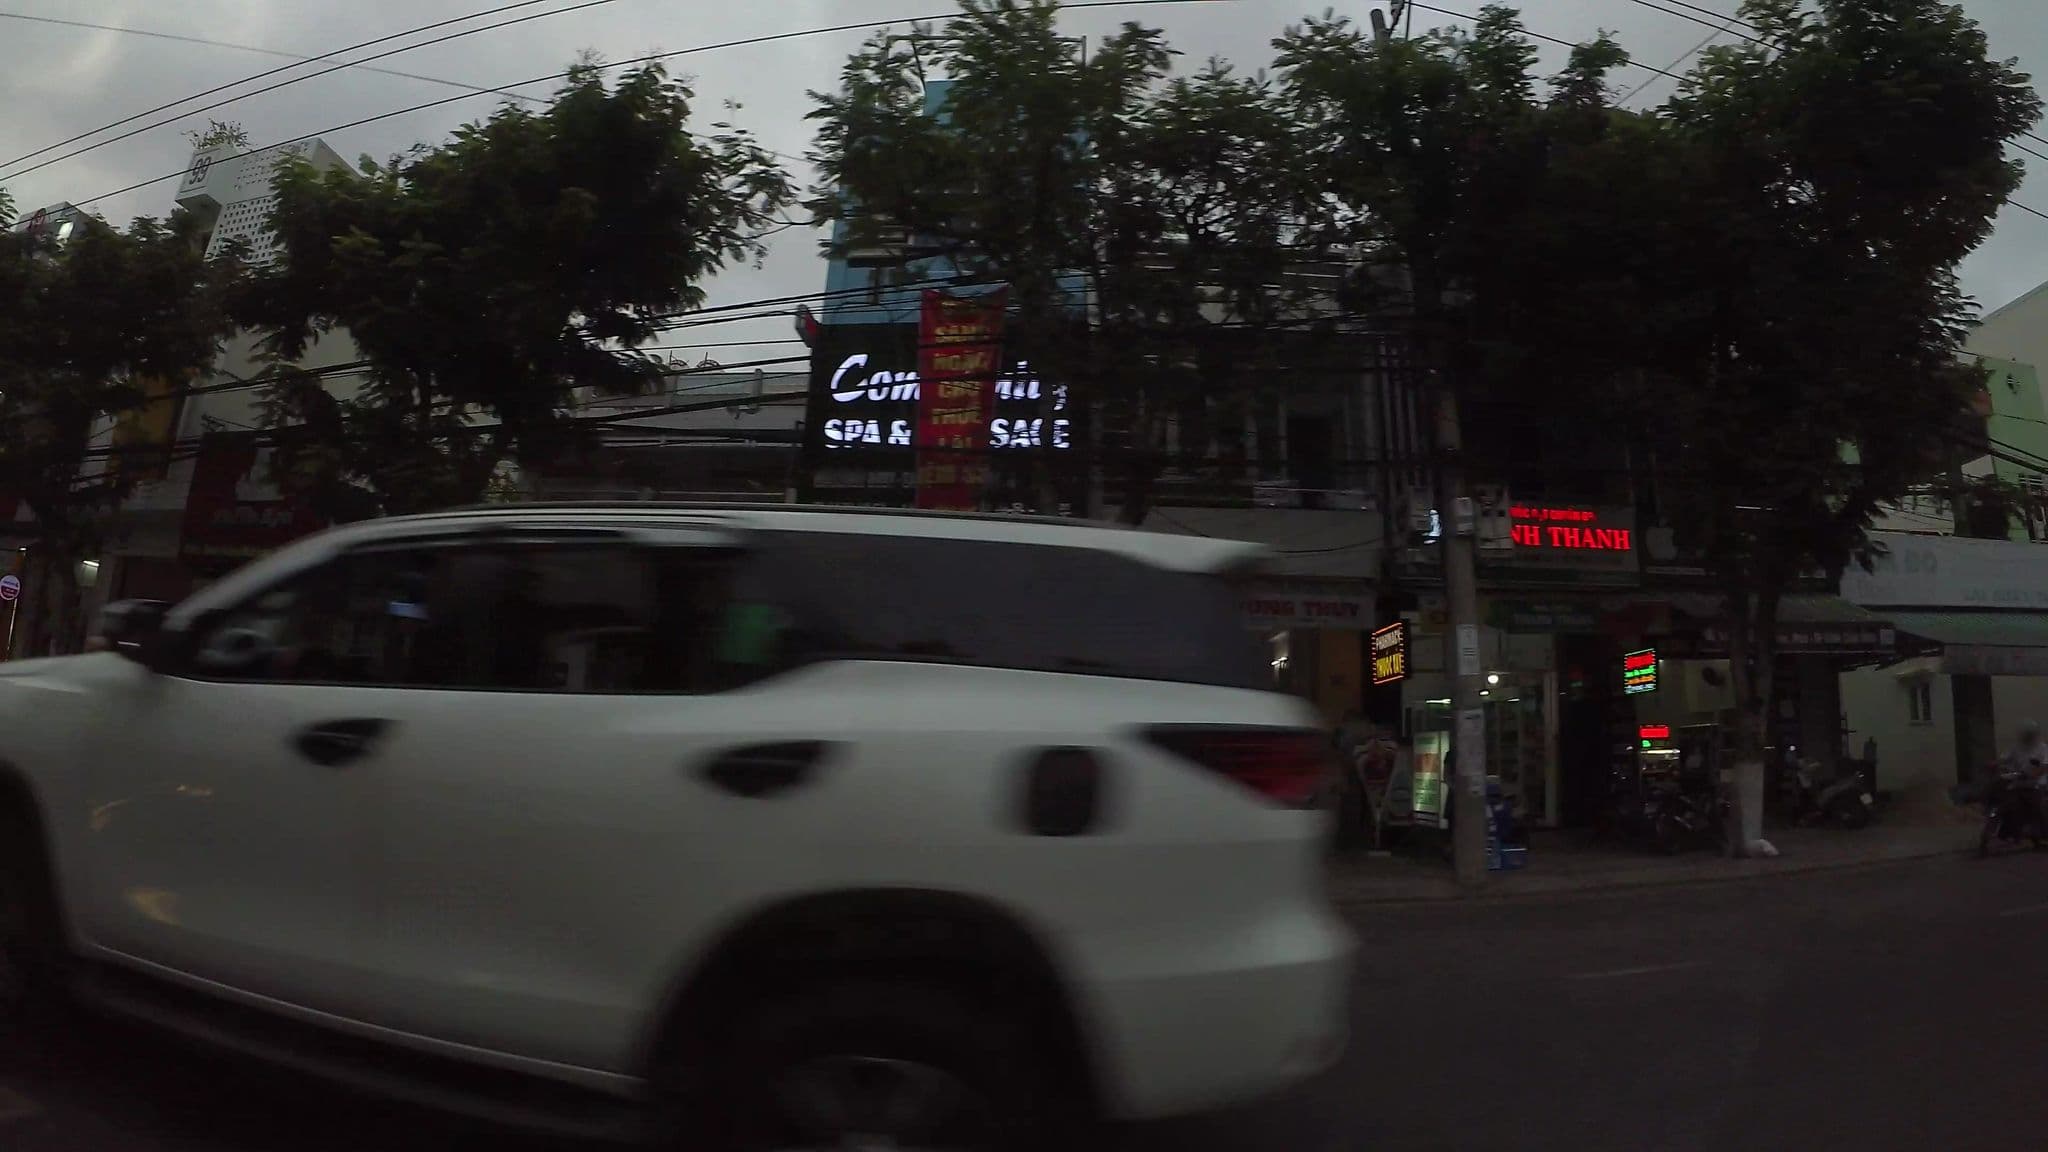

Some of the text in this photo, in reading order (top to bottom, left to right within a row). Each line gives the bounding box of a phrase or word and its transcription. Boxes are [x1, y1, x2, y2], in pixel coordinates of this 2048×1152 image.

[188, 156, 212, 185] 99
[823, 418, 881, 449] SPA
[887, 418, 912, 446] &
